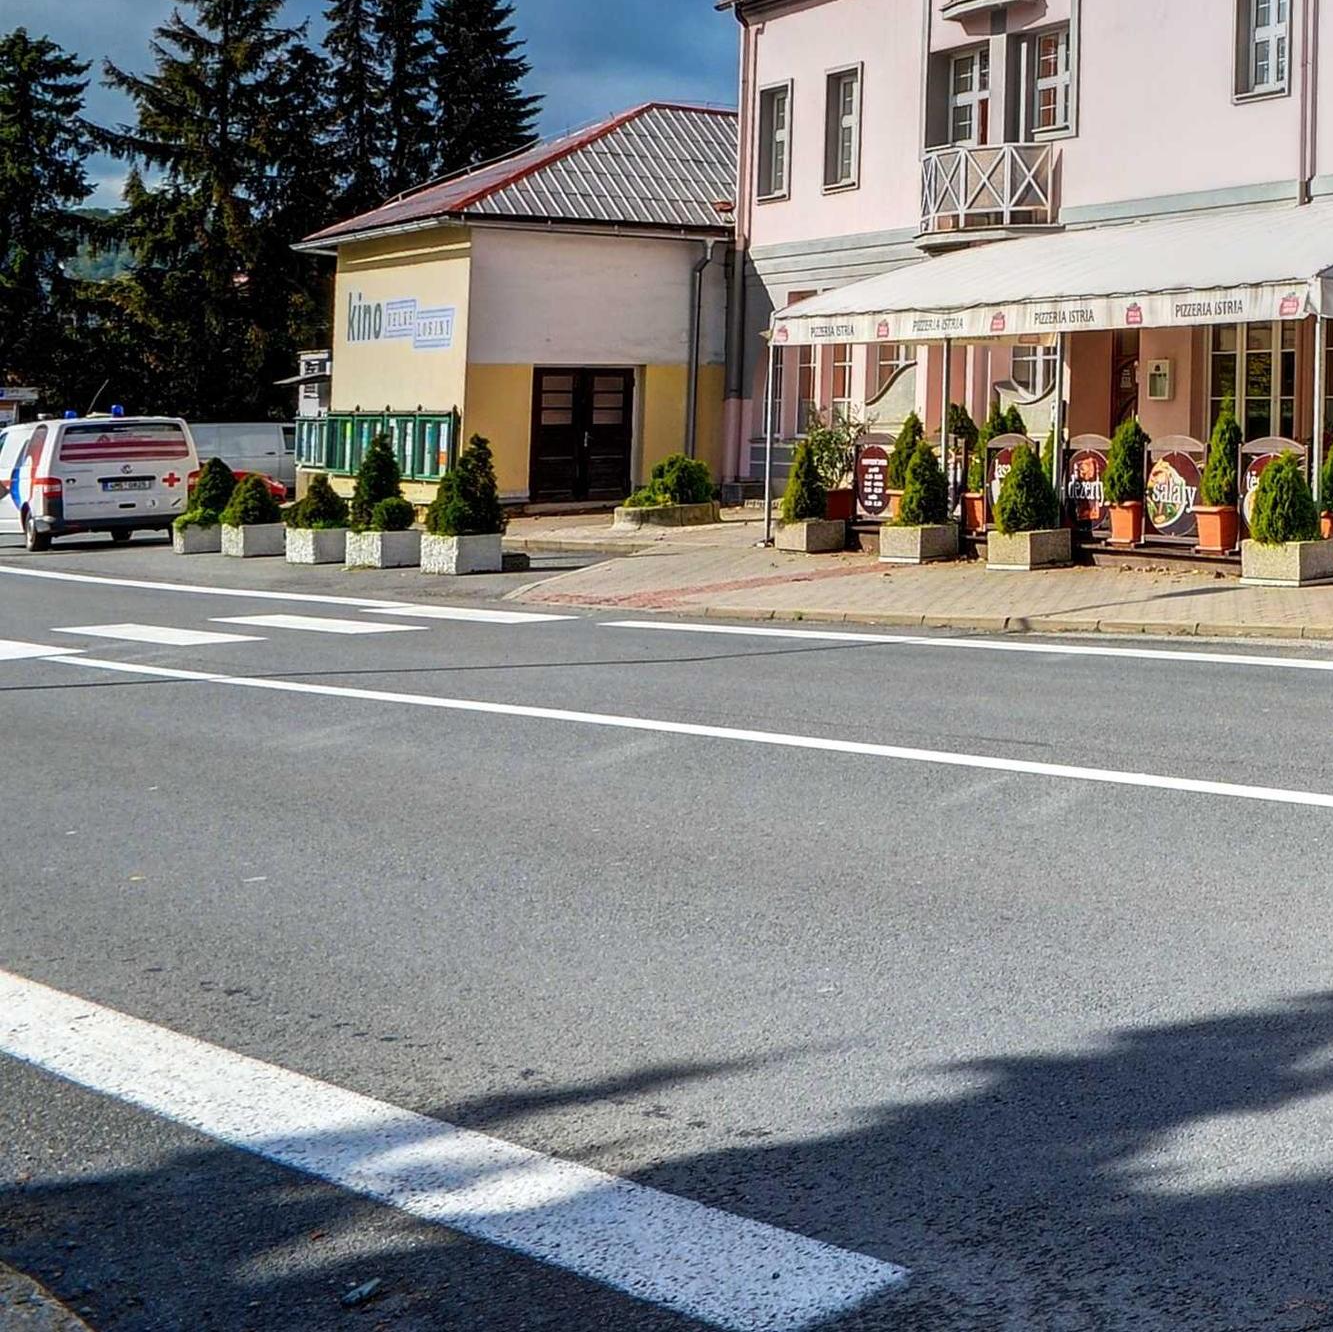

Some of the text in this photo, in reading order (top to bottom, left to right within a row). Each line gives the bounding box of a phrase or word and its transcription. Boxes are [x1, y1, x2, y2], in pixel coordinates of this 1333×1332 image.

[347, 292, 382, 342] kino
[1034, 308, 1095, 325] PIZZERIA ISTRIA
[1175, 299, 1244, 318] PIZZERIA ISTRIA
[1068, 474, 1104, 508] dezerty
